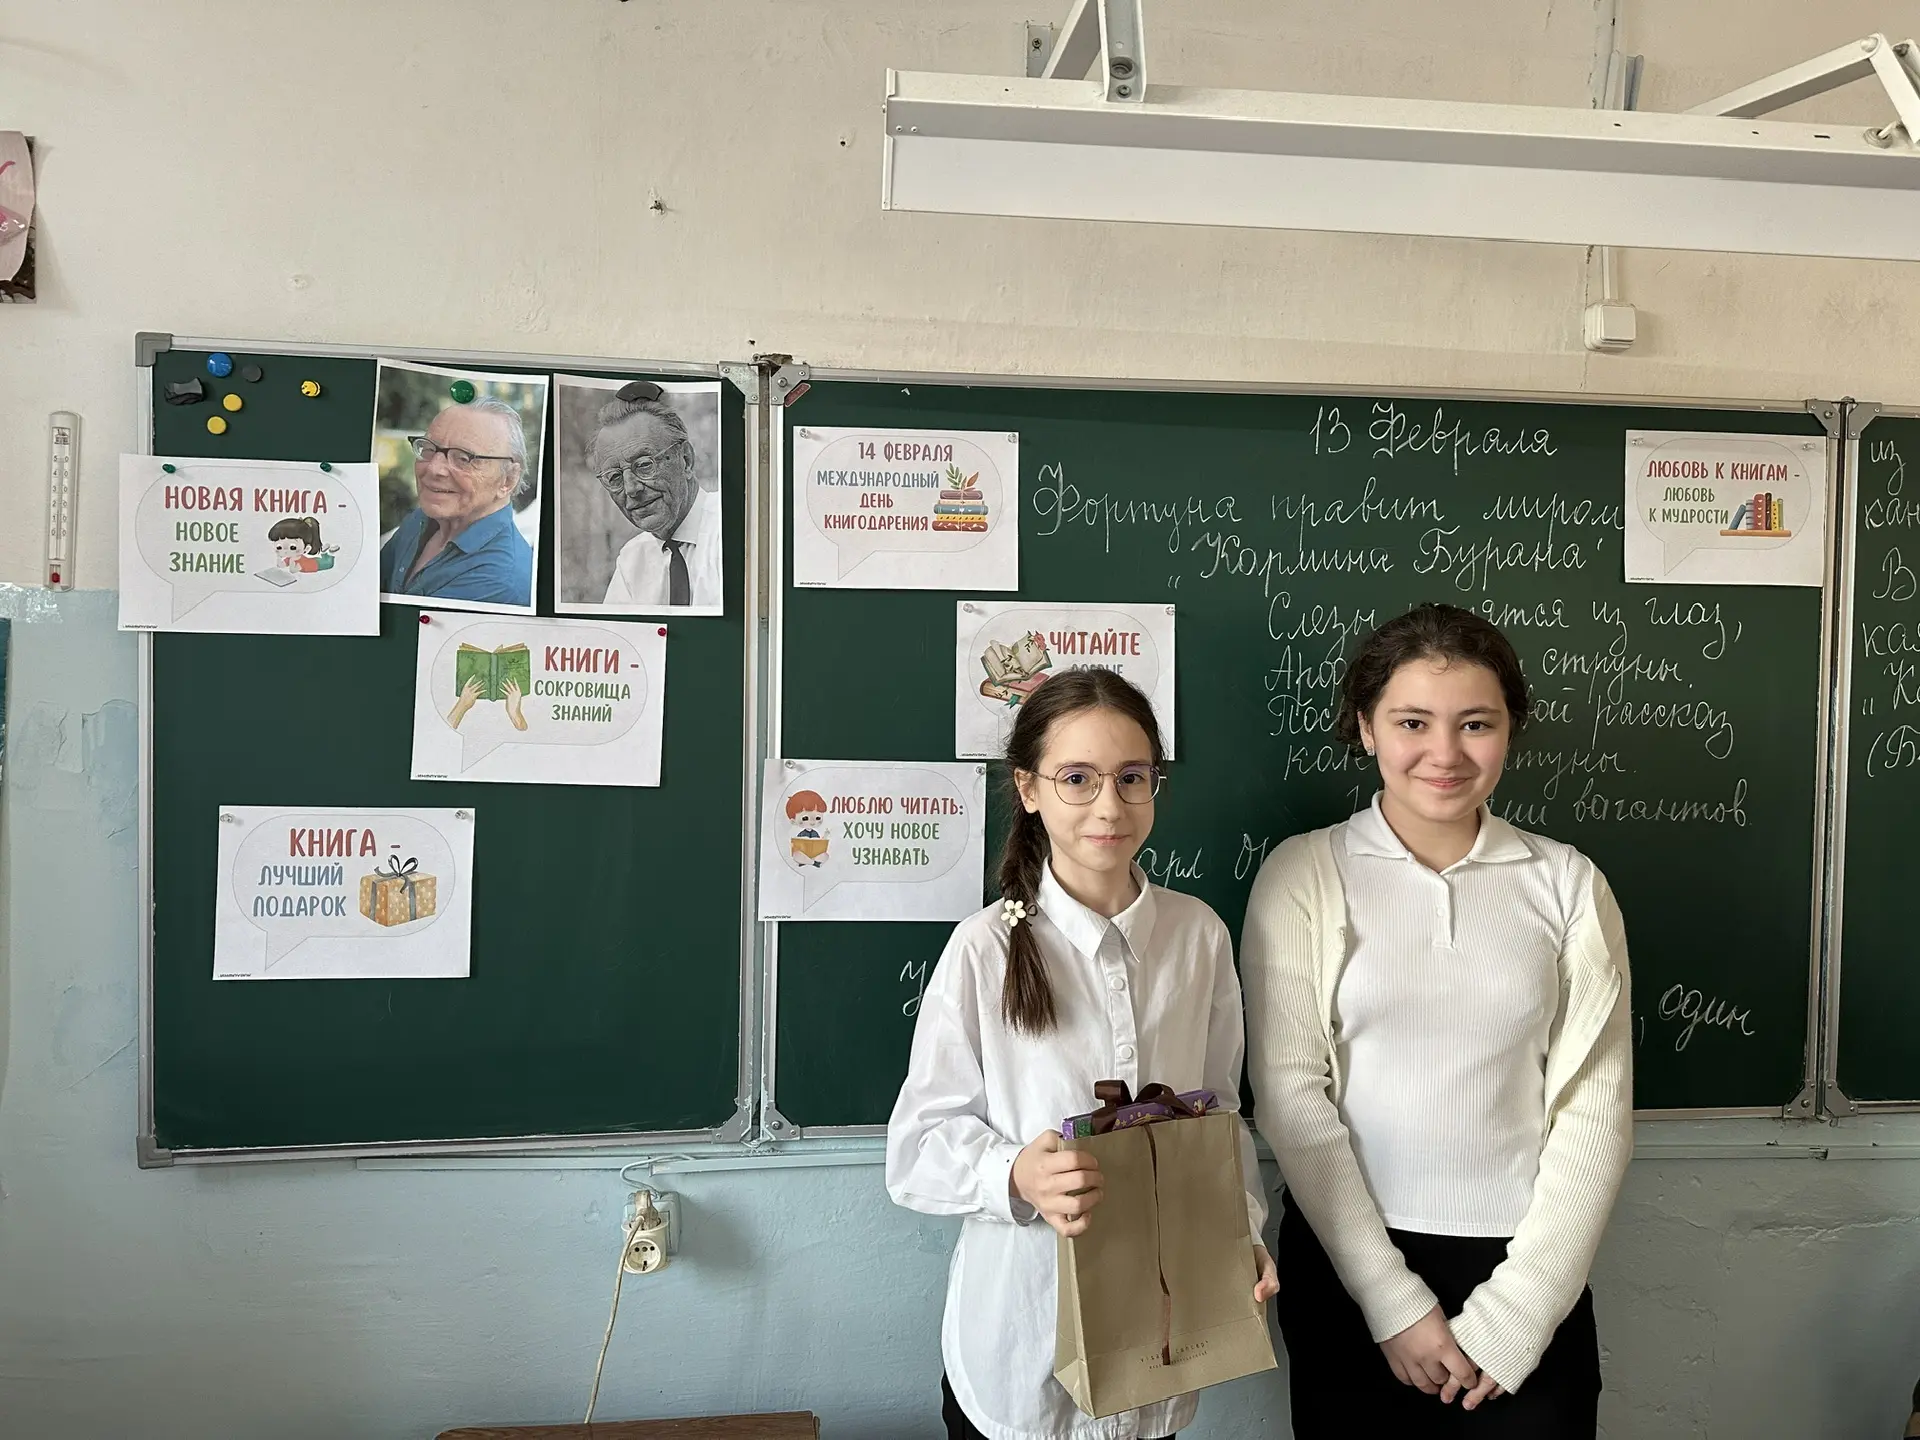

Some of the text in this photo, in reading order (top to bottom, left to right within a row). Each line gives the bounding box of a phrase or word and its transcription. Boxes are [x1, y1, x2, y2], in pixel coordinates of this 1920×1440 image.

[1309, 401, 1557, 476] 13 Февраля
[858, 441, 953, 463] 14 ФЕВРАЛЯ
[817, 470, 939, 489] МЕЖДУНАРОДНЫЙ
[1646, 460, 1709, 479] ЛЮБОВЬ
[1715, 462, 1725, 480] К
[1731, 463, 1788, 482] КНИГАМ
[165, 485, 243, 512] НОВАЯ
[254, 488, 328, 514] КНИГА
[859, 492, 894, 508] ДЕНЬ
[1663, 486, 1715, 503] ЛЮБОВЬ
[1033, 462, 1625, 553] Фортуна правит миром
[1649, 507, 1729, 525] К МУДРОСТИ
[175, 521, 240, 543] НОВОЕ
[824, 514, 929, 531] КНИГОДАРЕНИЯ
[169, 551, 246, 574] ЗНАНИЕ
[1592, 600, 1628, 656] из
[1049, 628, 1141, 656] ЧИТАЙТЕ
[544, 646, 620, 674] КНИГИ
[534, 679, 631, 702] СОКРОВИЩА
[1264, 645, 1348, 717] Арф
[551, 704, 613, 723] ЗНАНИЙ
[1592, 694, 1734, 759] рассказ
[830, 796, 964, 816] ЛЮБЛЮ ЧИТАТЬ:
[843, 821, 940, 840] ХОЧУ НОВОЕ
[289, 828, 377, 857] КНИГА
[852, 847, 930, 866] УЗНАВАТЬ
[1136, 847, 1204, 888] арл
[258, 862, 344, 886] ЛУЧШИЙ
[252, 895, 347, 917] ПОДАРОК
